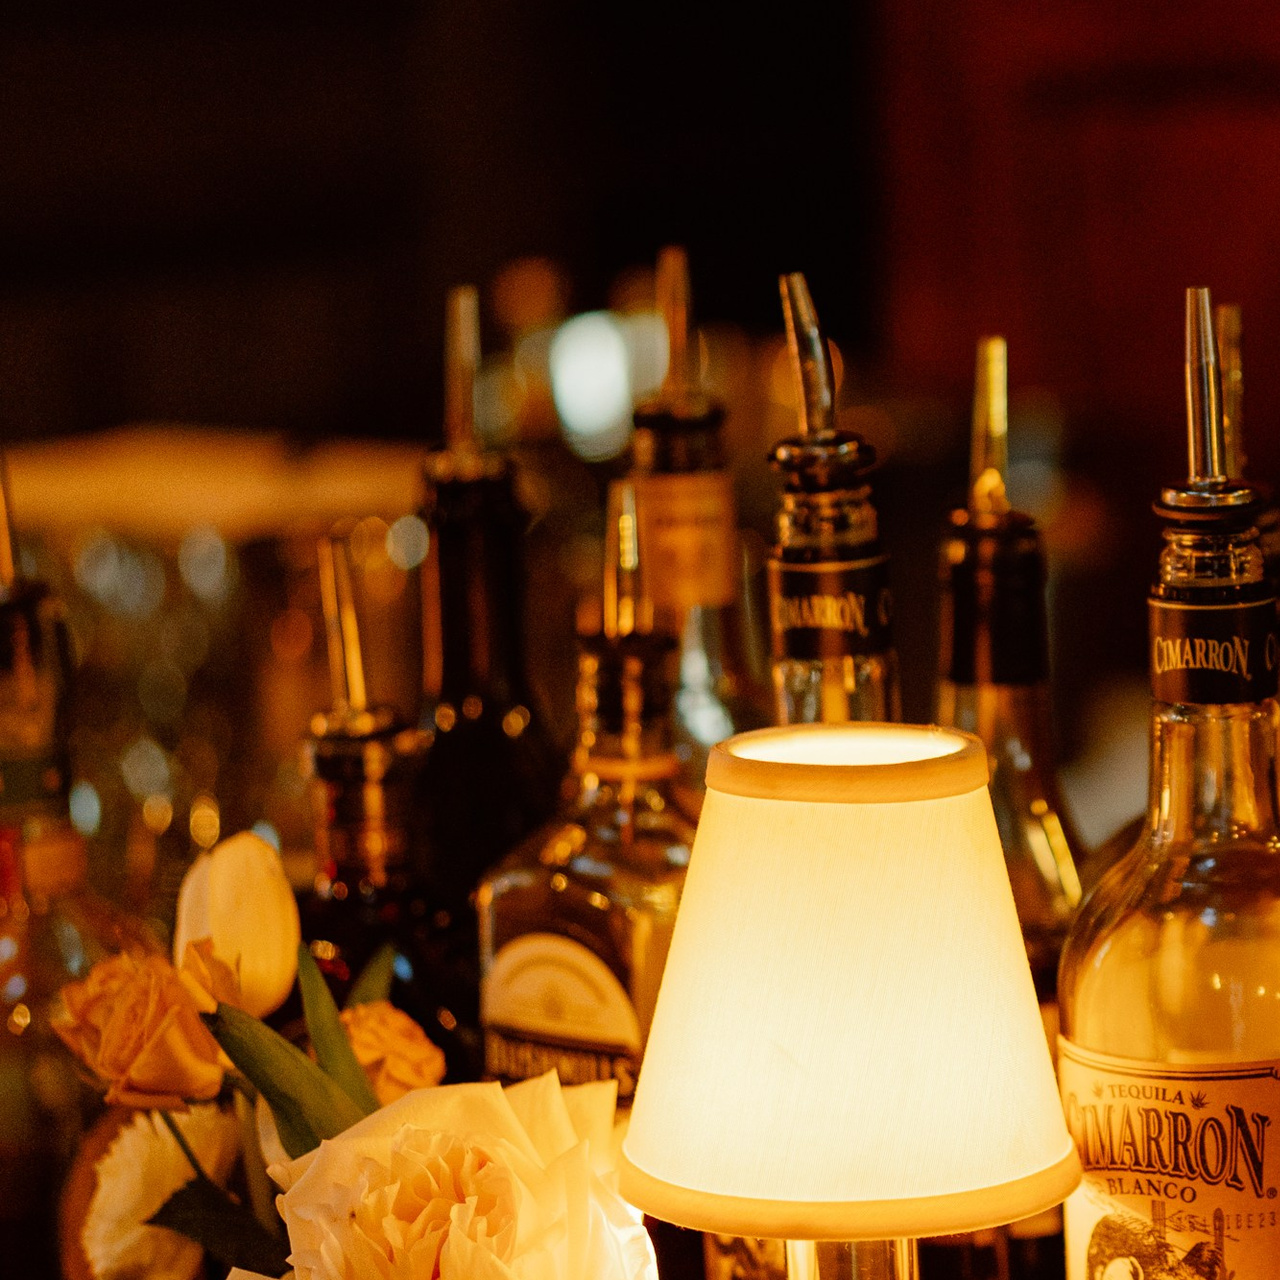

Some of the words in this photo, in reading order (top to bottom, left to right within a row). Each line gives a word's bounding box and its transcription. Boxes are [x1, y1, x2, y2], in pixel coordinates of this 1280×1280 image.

[1154, 635, 1250, 681] CIMARRON
[1108, 1084, 1185, 1105] TEQUILA
[1106, 1178, 1197, 1203] BLANCO
